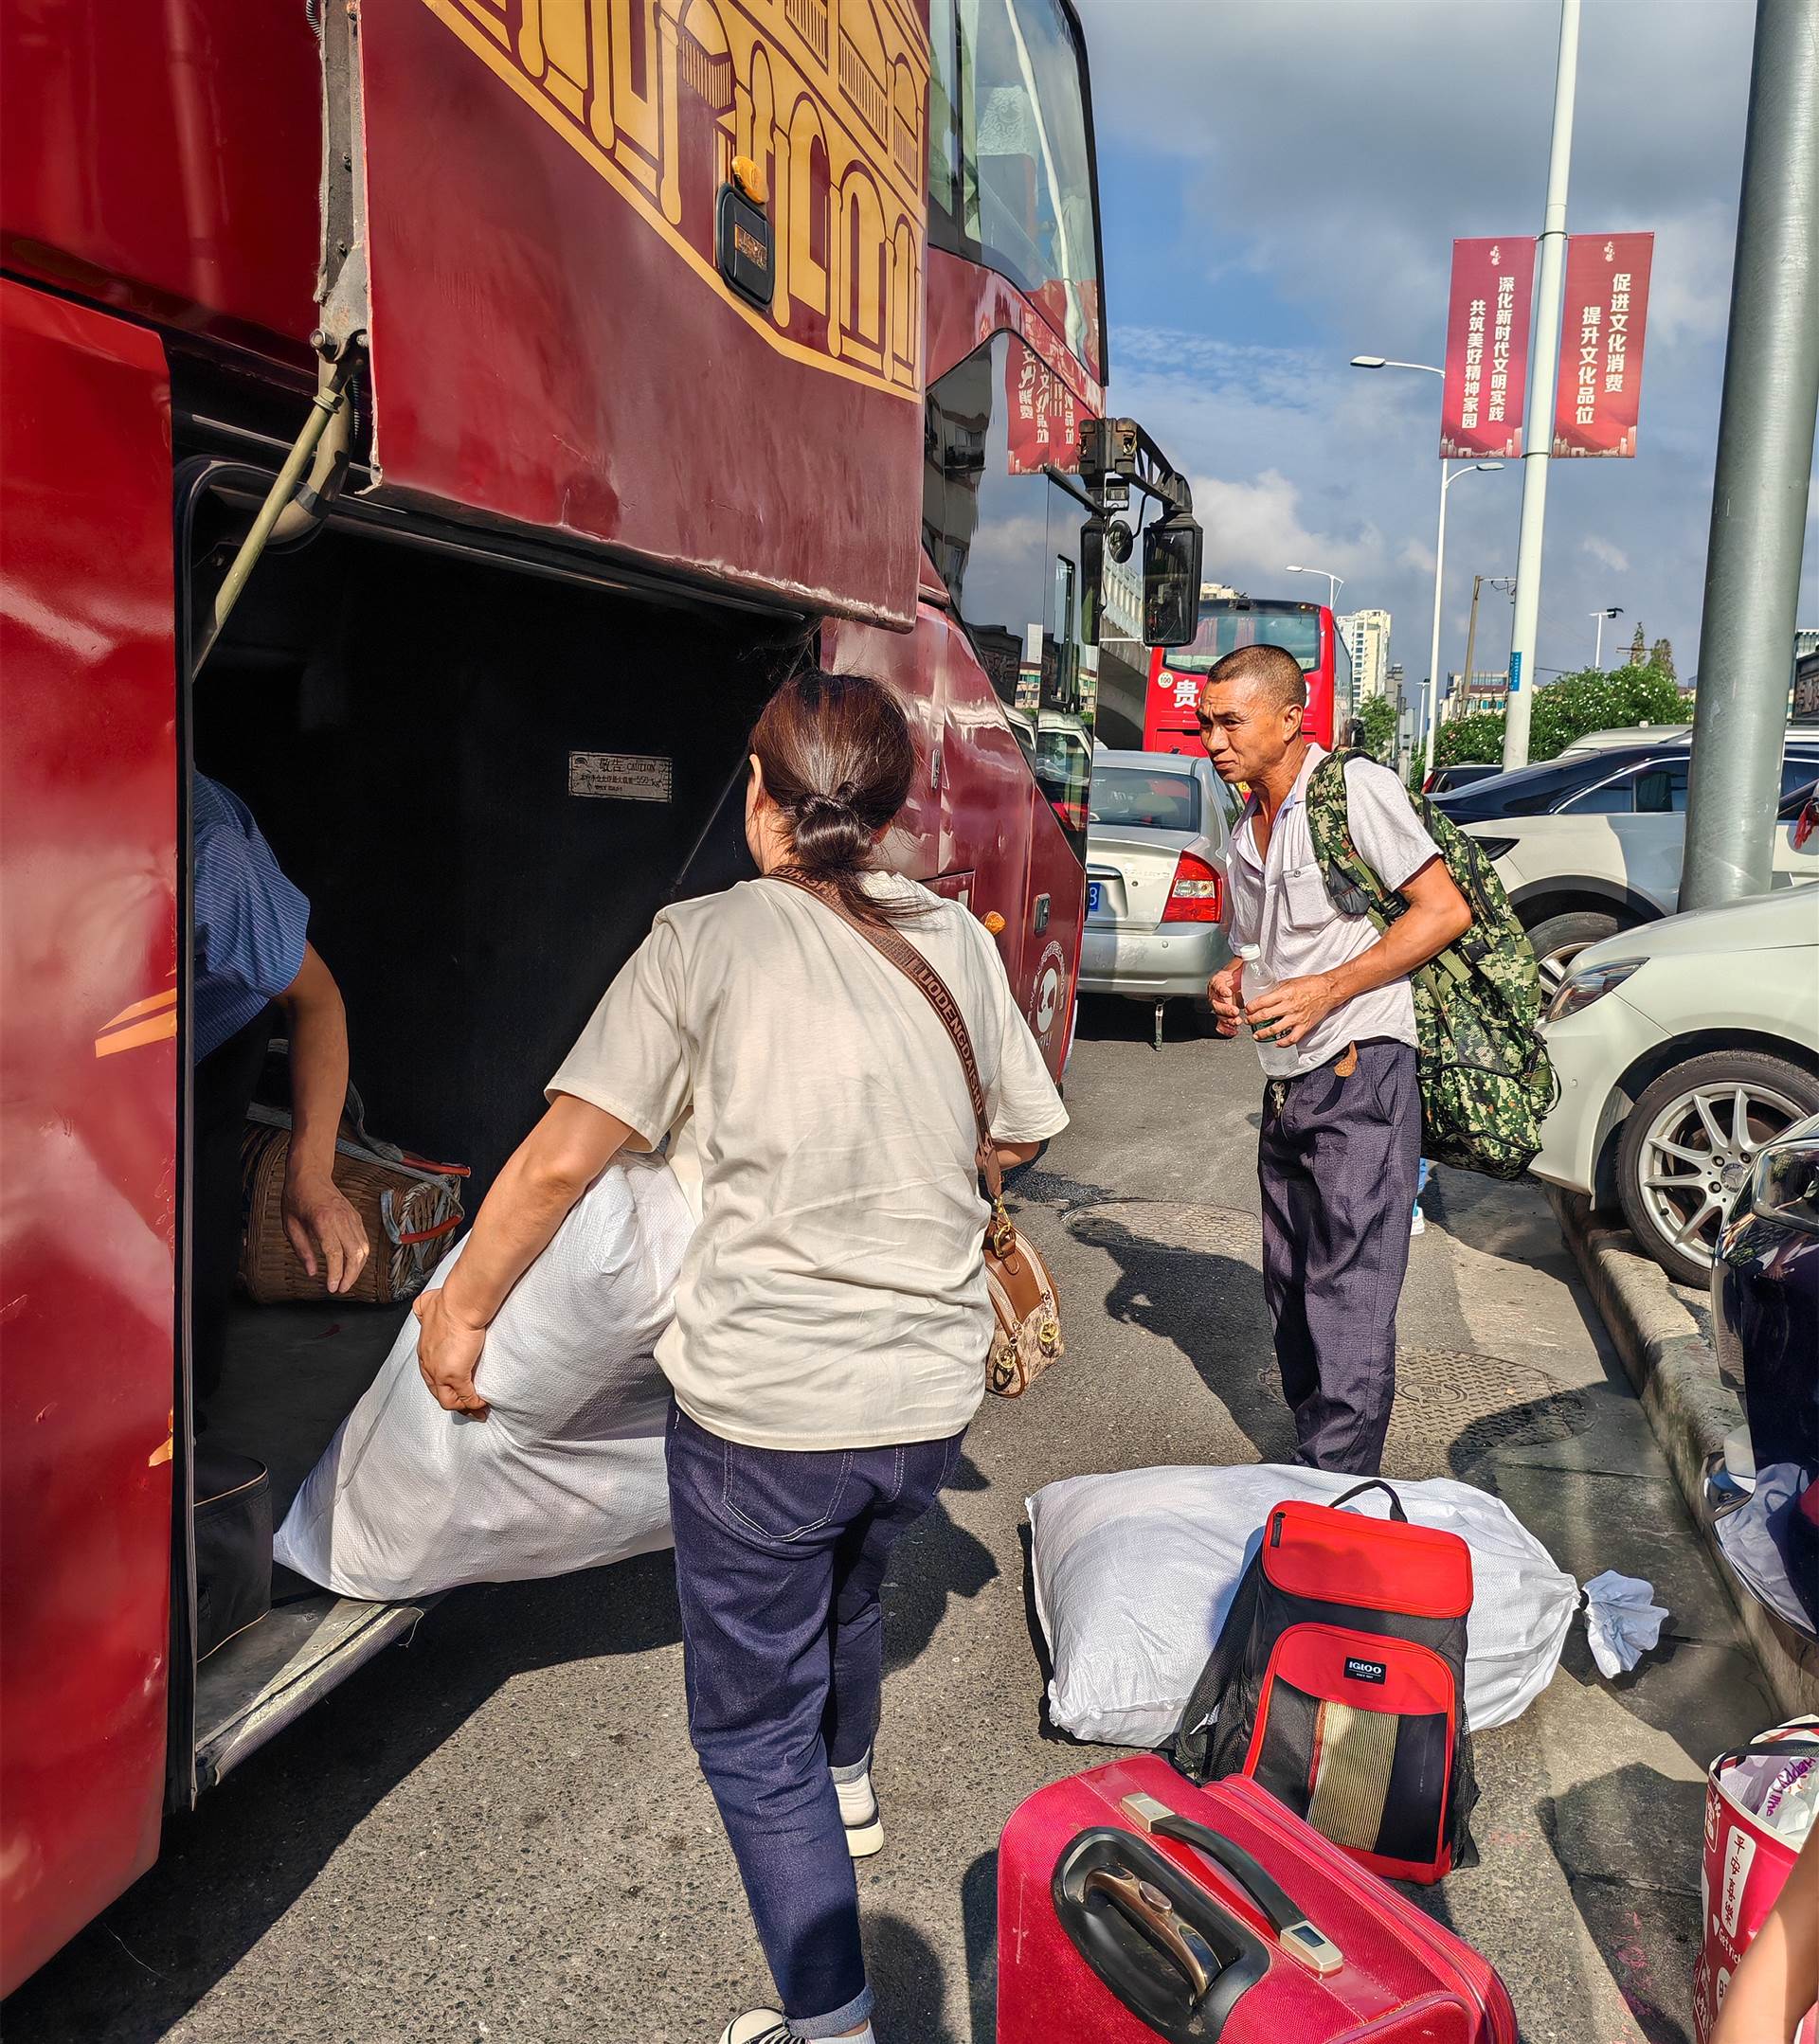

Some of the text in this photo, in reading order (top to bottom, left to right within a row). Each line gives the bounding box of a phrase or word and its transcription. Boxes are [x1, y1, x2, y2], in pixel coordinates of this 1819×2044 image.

[1461, 299, 1486, 429] 共筑美好精神家园
[1488, 276, 1515, 422] 深化新时代文明实践
[1576, 306, 1601, 425] 提升文化品位
[1604, 273, 1631, 393] 促进文化消费
[1173, 679, 1200, 708] 贵
[1348, 1660, 1381, 1675] IGLOO
